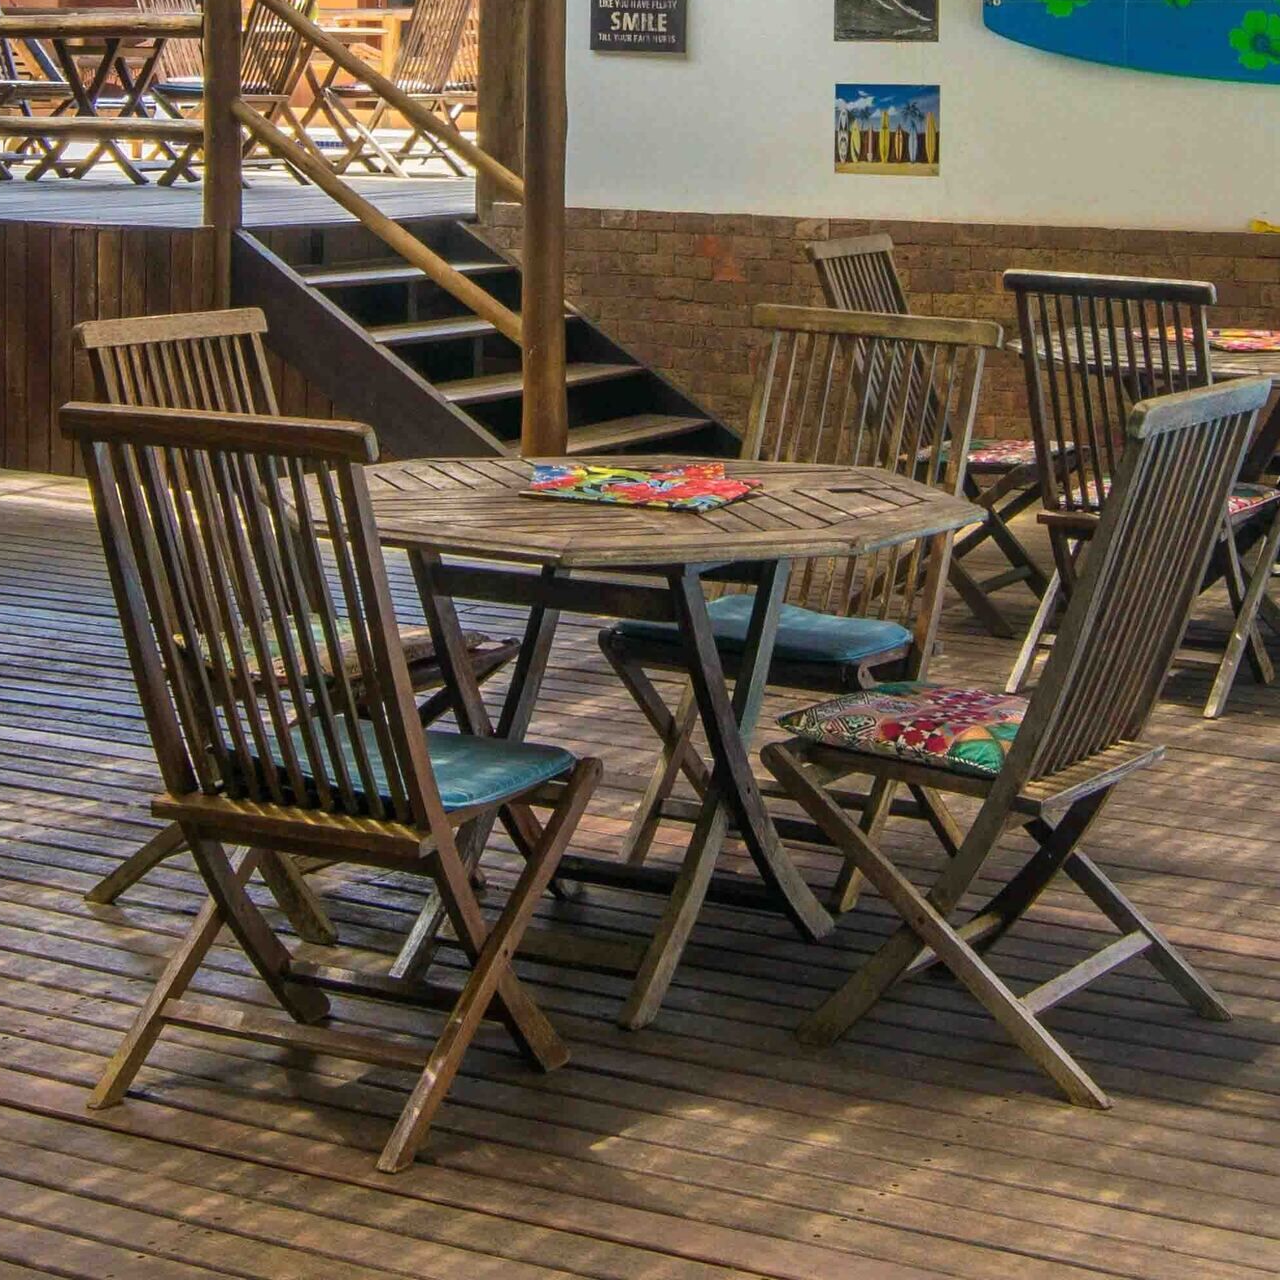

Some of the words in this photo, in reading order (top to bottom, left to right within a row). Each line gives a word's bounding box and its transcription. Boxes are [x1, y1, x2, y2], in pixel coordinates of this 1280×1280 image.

[599, 0, 614, 8] LIKE
[630, 0, 651, 9] HAVE
[610, 11, 668, 32] SMILE
